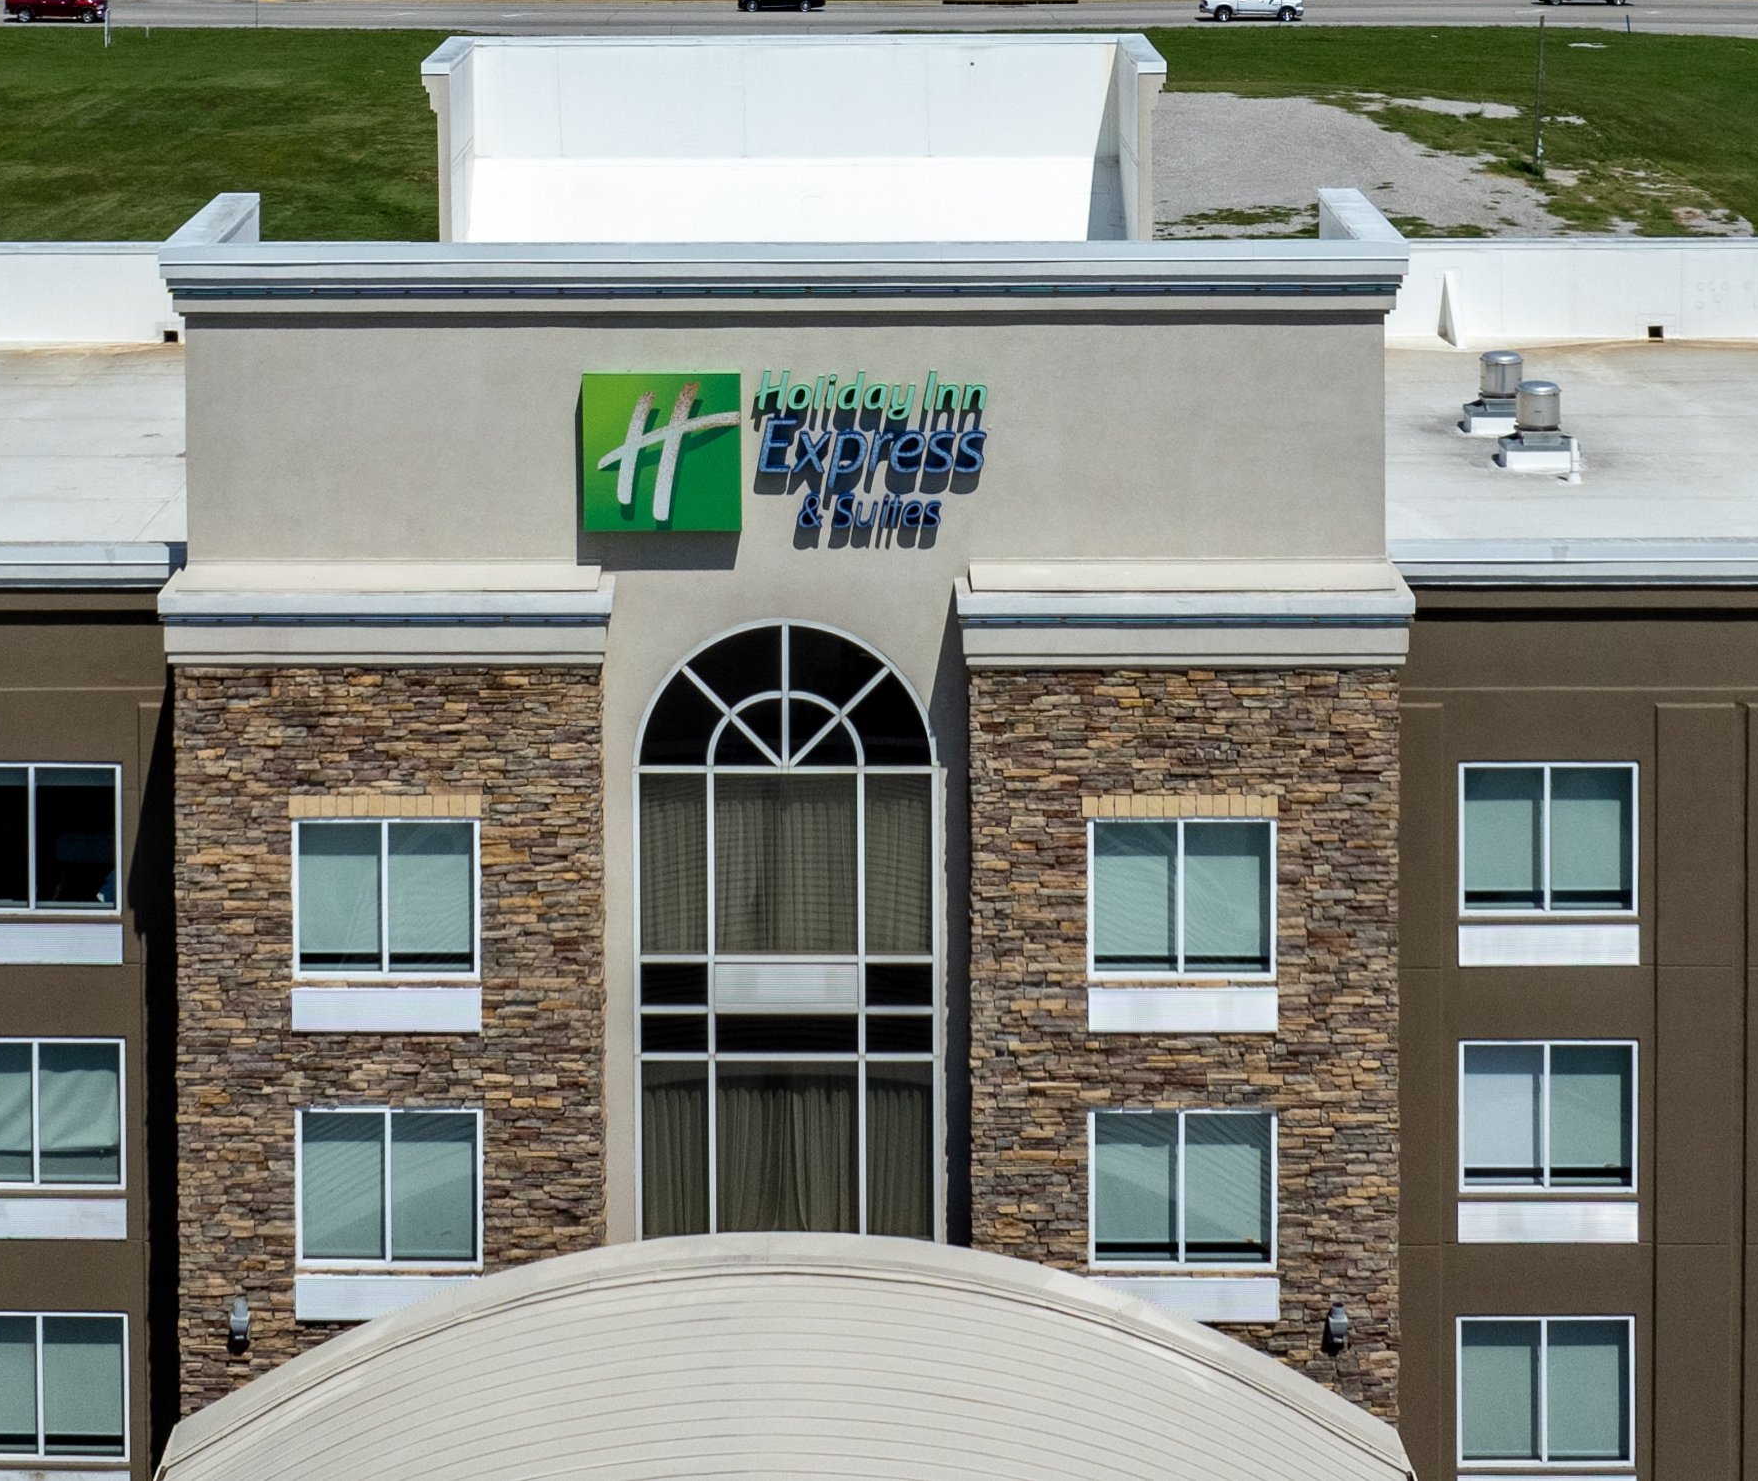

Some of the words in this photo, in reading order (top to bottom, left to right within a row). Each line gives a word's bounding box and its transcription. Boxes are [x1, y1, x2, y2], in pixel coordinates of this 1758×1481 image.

[753, 368, 917, 420] Holiday
[924, 369, 989, 411] Inn
[757, 413, 988, 490] Express
[798, 493, 823, 529] &
[832, 491, 942, 529] Suites
